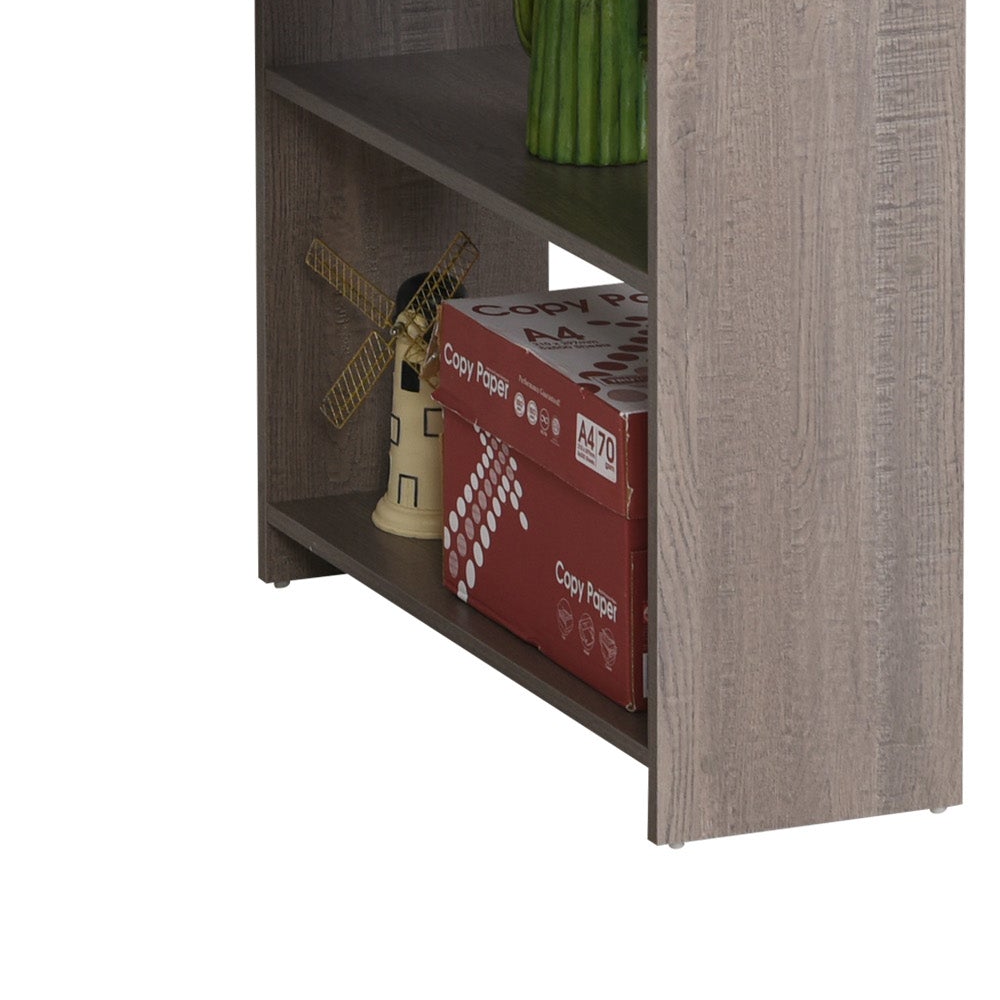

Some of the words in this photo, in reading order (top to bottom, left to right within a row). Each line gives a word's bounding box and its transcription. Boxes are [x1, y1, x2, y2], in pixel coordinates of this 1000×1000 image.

[472, 299, 589, 316] Copy
[523, 326, 585, 342] A4
[443, 342, 474, 381] Copy
[476, 361, 510, 400] Paper
[578, 419, 595, 450] A4
[598, 430, 615, 464] 70
[555, 560, 584, 603] Copy
[586, 581, 618, 622] Paper
